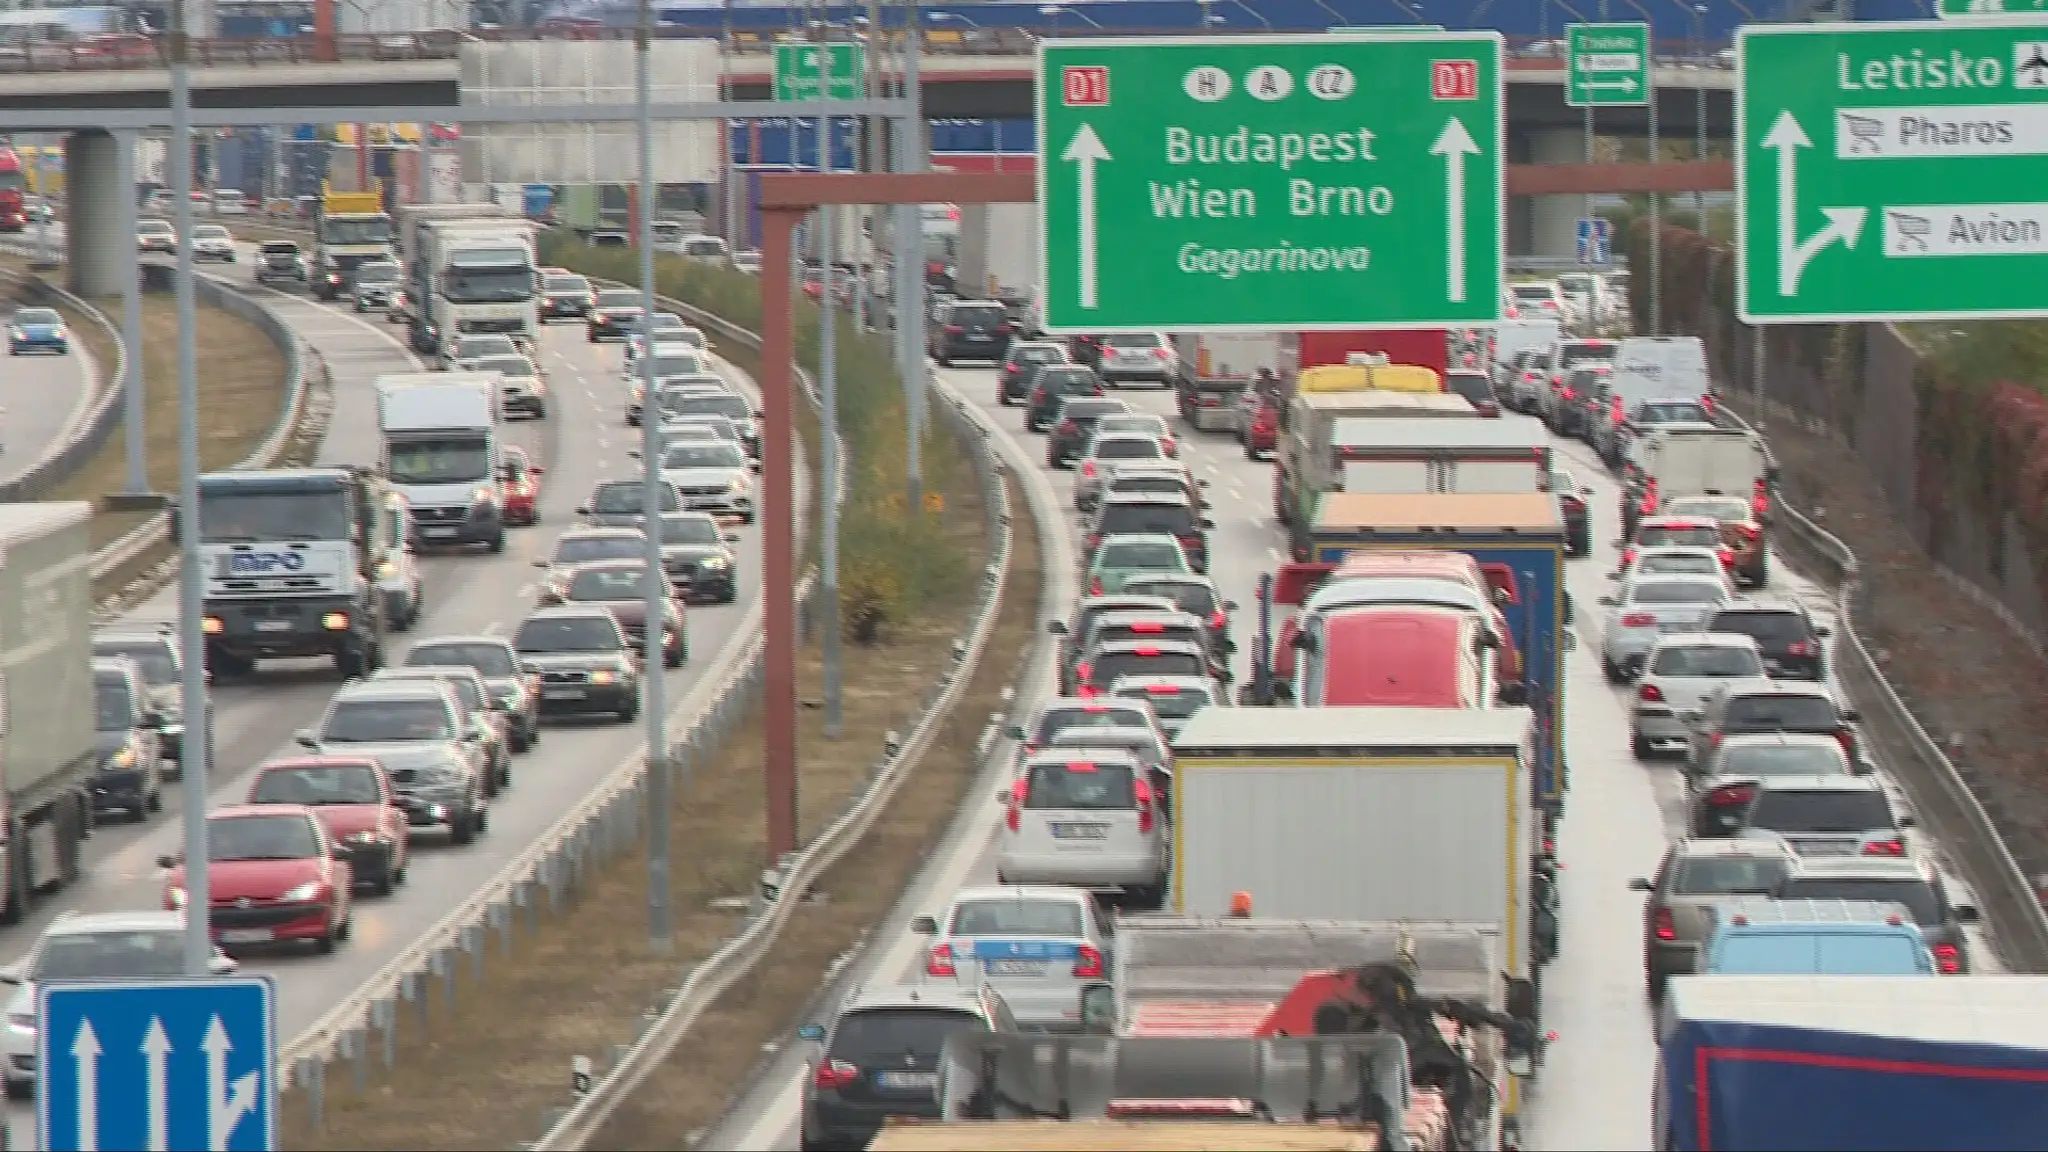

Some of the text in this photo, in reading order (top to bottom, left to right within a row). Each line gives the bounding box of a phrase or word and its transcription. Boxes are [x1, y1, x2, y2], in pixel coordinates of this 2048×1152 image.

[1199, 69, 1345, 96] H A CZ
[1439, 65, 1472, 95] D1
[1837, 47, 2003, 90] Letisko
[1067, 72, 1102, 100] D1
[1899, 116, 2015, 146] Pharos
[1165, 125, 1377, 170] Budapest
[1149, 178, 1394, 219] Wien Brno
[1947, 212, 2041, 244] Avion
[1178, 240, 1370, 278] Gagarinova
